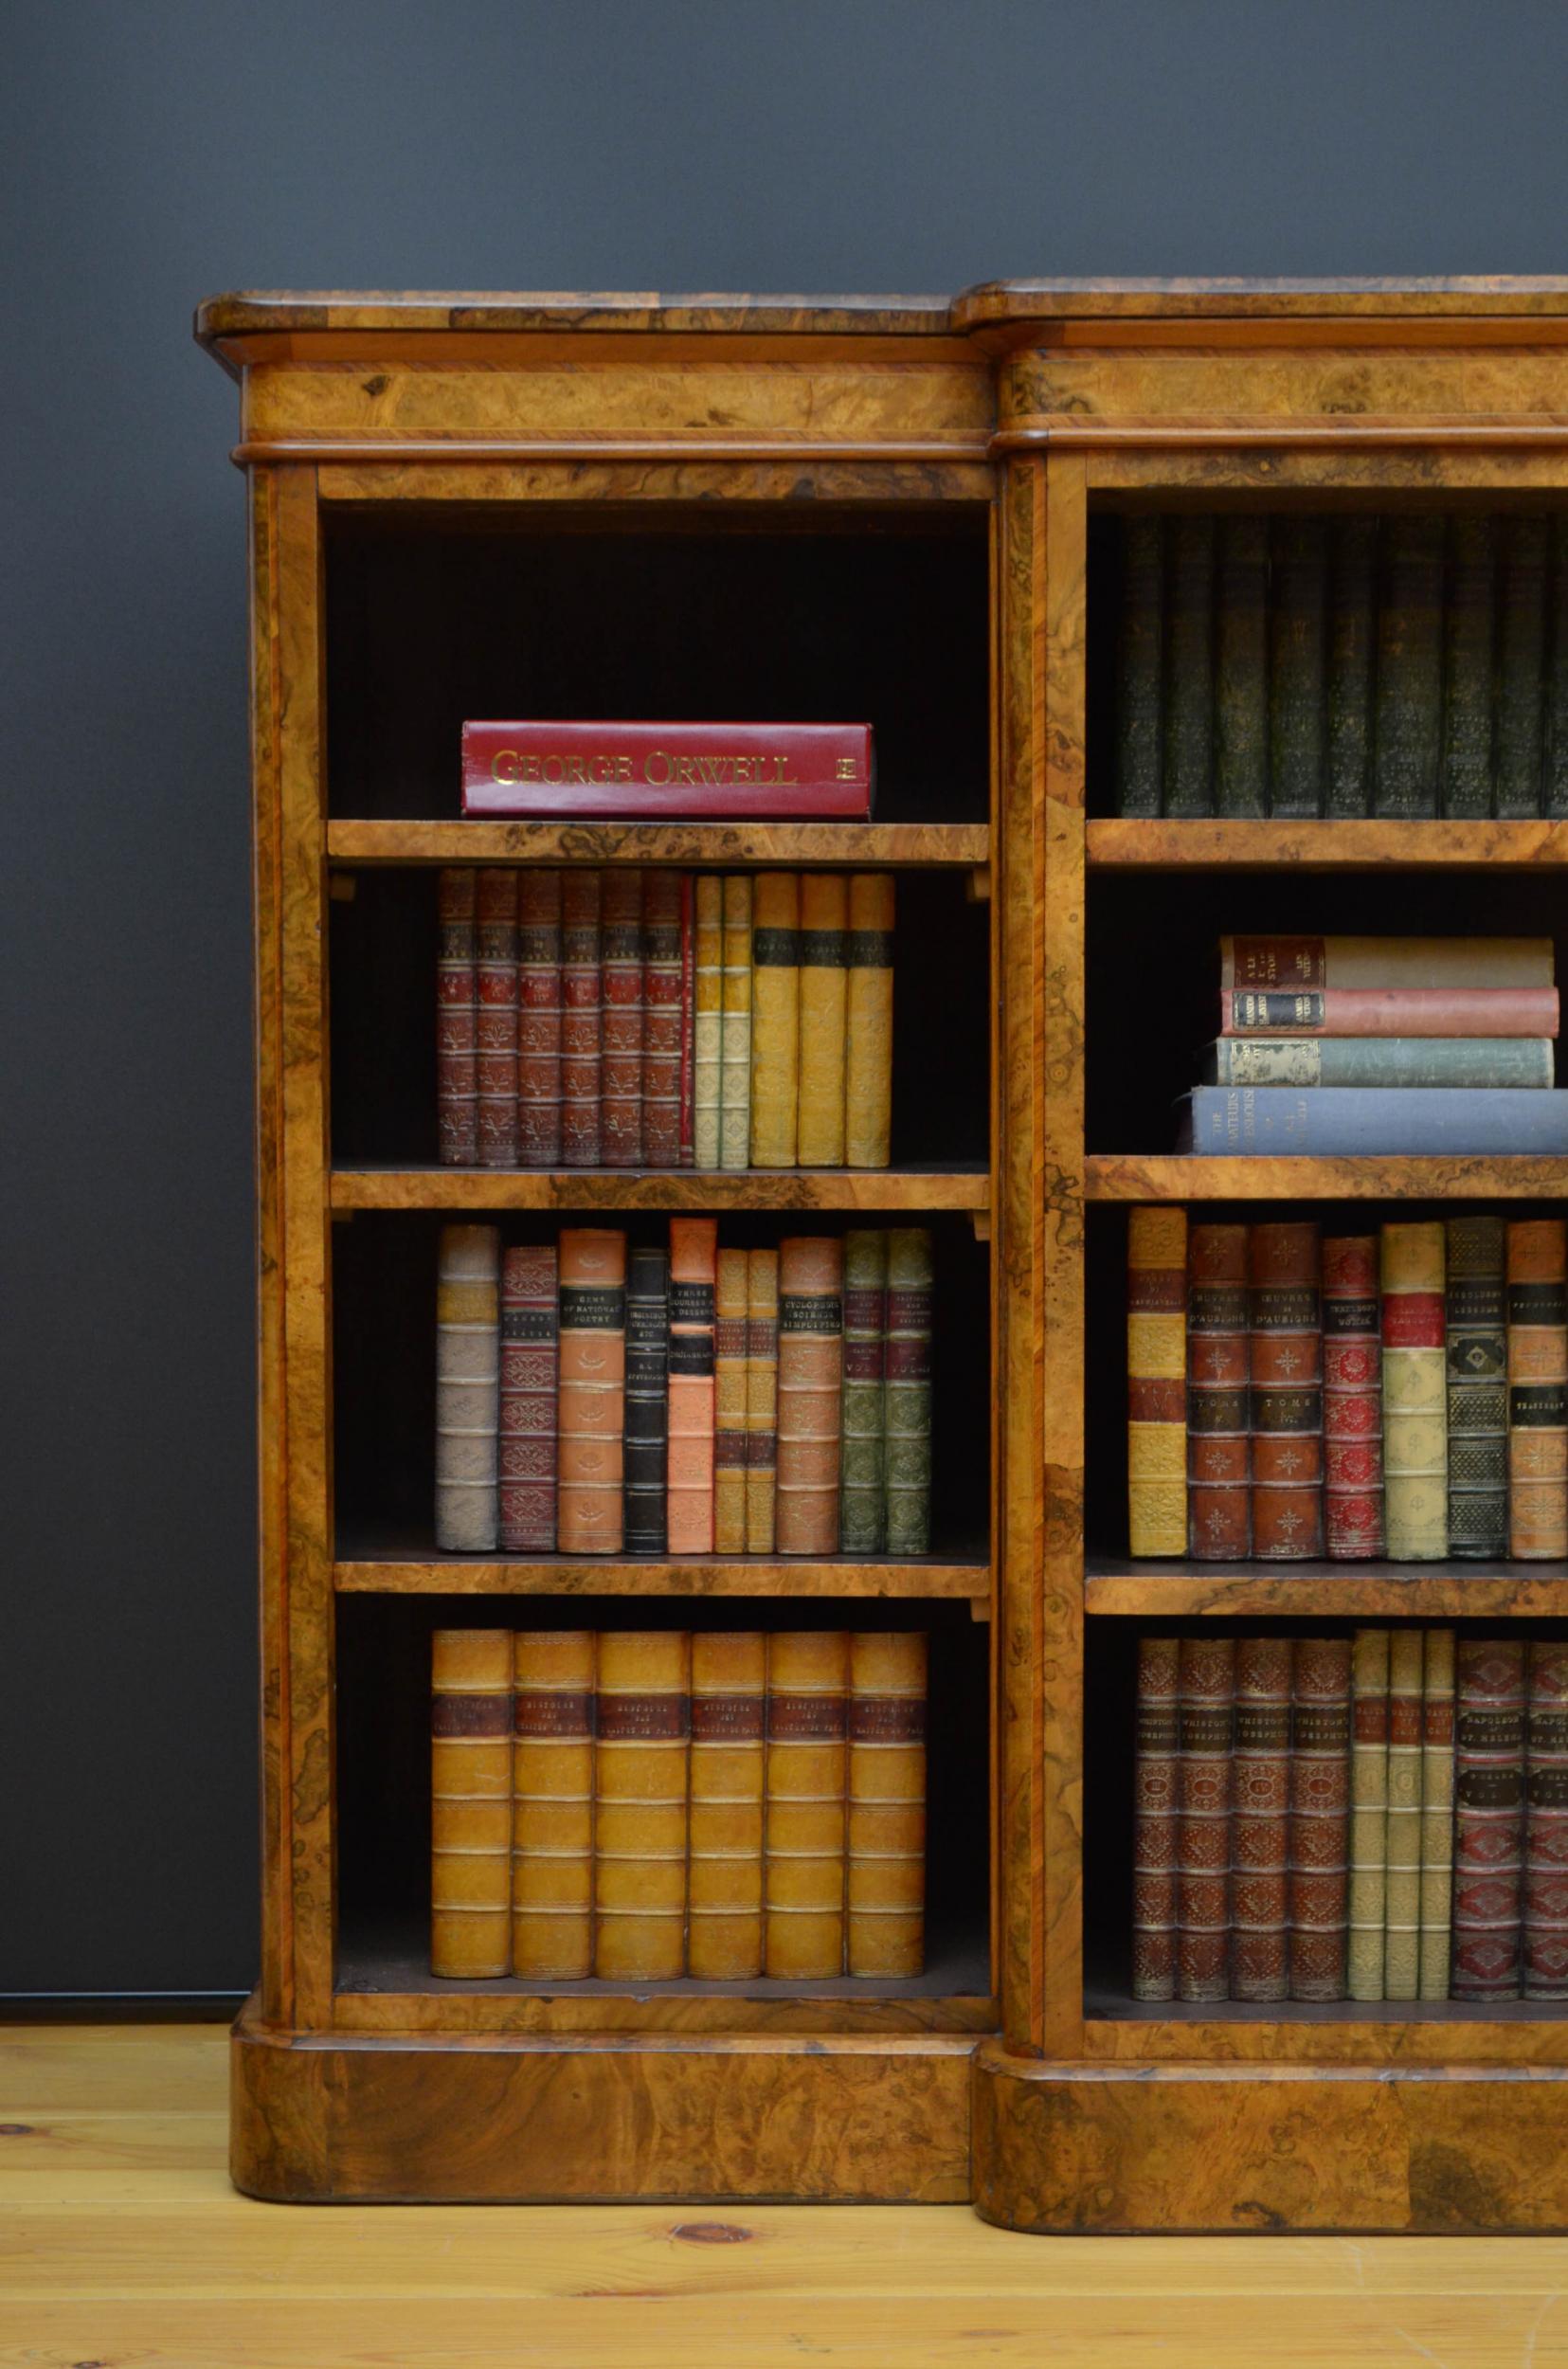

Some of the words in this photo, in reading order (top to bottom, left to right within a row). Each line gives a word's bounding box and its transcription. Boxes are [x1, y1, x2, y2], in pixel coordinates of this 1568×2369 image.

[491, 750, 634, 786] GEORGE
[644, 750, 798, 786] ORWELL
[1265, 1399, 1311, 1407] TOME
